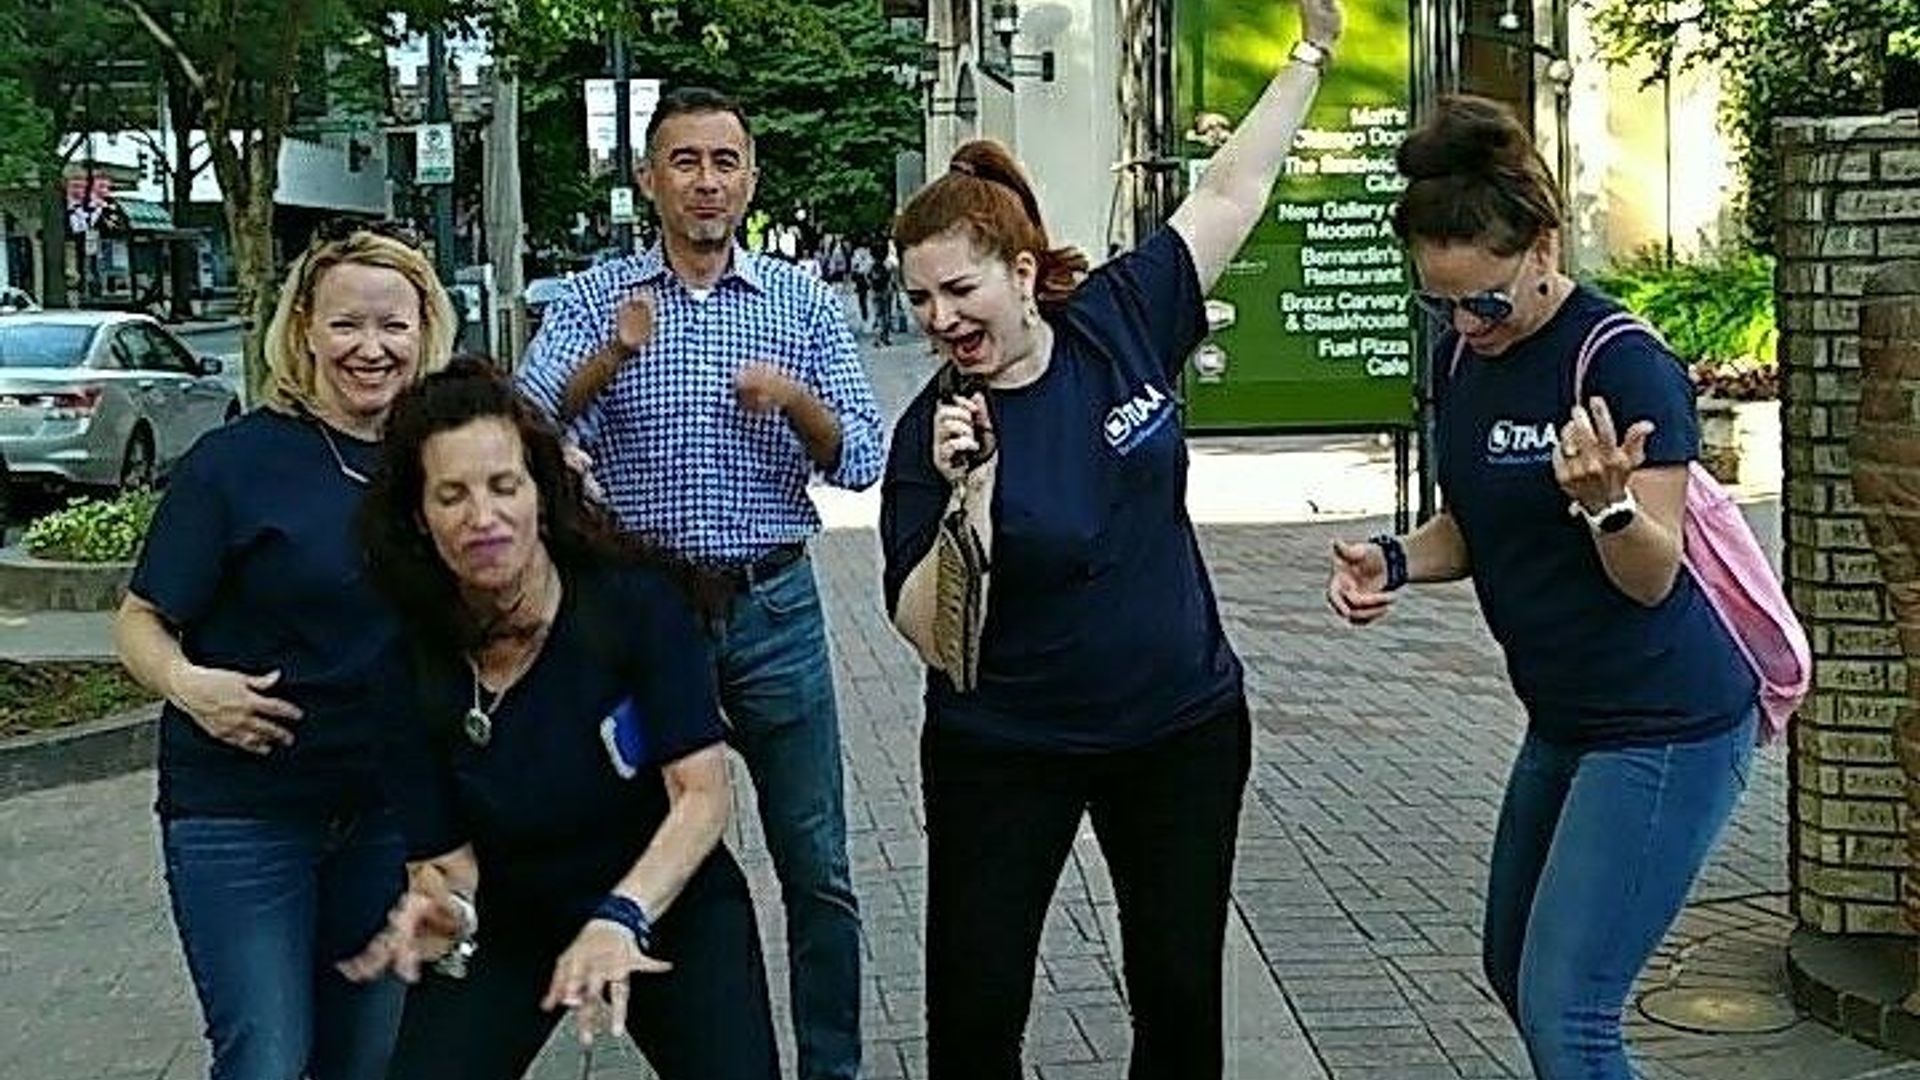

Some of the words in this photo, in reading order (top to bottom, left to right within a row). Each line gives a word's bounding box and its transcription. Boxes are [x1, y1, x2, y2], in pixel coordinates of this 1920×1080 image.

[1285, 156, 1319, 174] The
[1365, 175, 1409, 192] Club
[1278, 204, 1319, 220] New
[1322, 201, 1385, 220] Gallery
[1306, 222, 1377, 239] Modern
[1301, 246, 1402, 266] Bernardin's
[1304, 268, 1403, 285] Restaurant
[1281, 291, 1334, 312] Brazz
[1337, 291, 1411, 312] Carvery
[1285, 312, 1300, 332] &
[1303, 312, 1409, 331] Steakhouse
[1319, 338, 1358, 357] Fuel
[1360, 337, 1409, 355] Pizza
